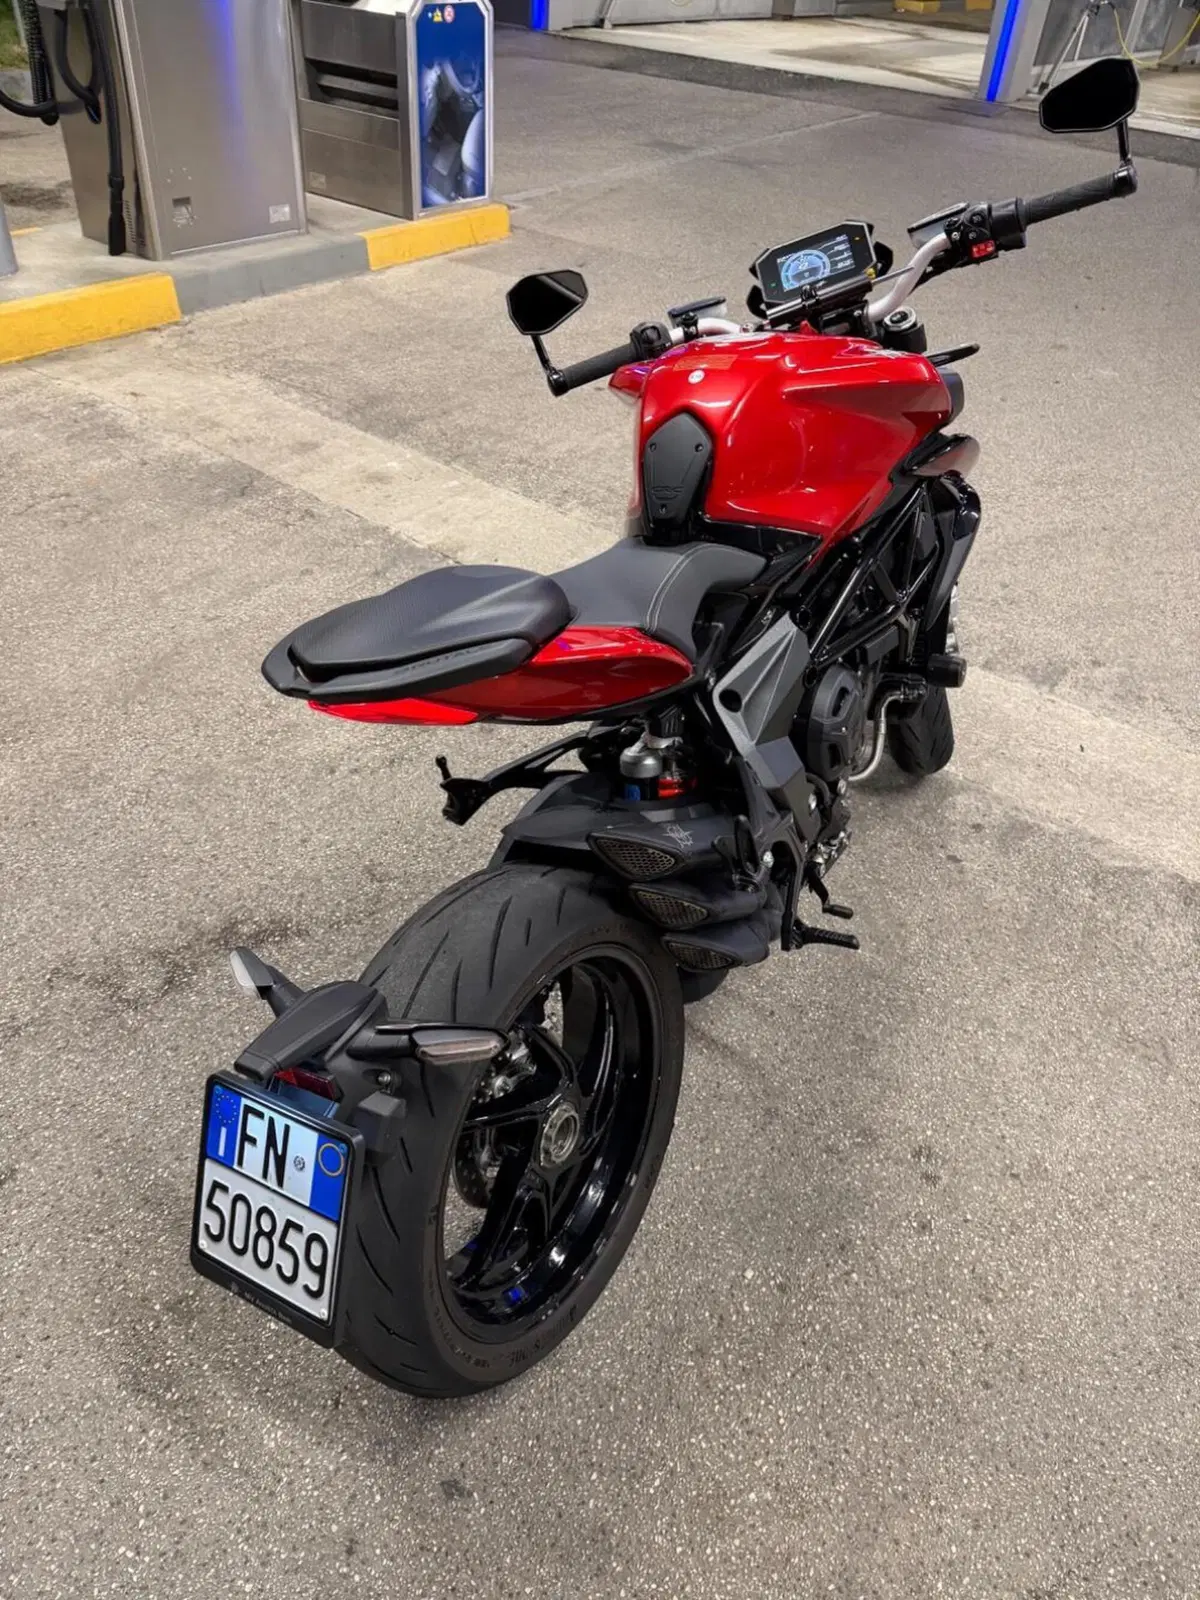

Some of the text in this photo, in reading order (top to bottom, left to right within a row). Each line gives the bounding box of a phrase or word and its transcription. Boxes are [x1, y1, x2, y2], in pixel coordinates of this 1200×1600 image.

[218, 1104, 291, 1188] I FN
[204, 1180, 329, 1299] 50859
